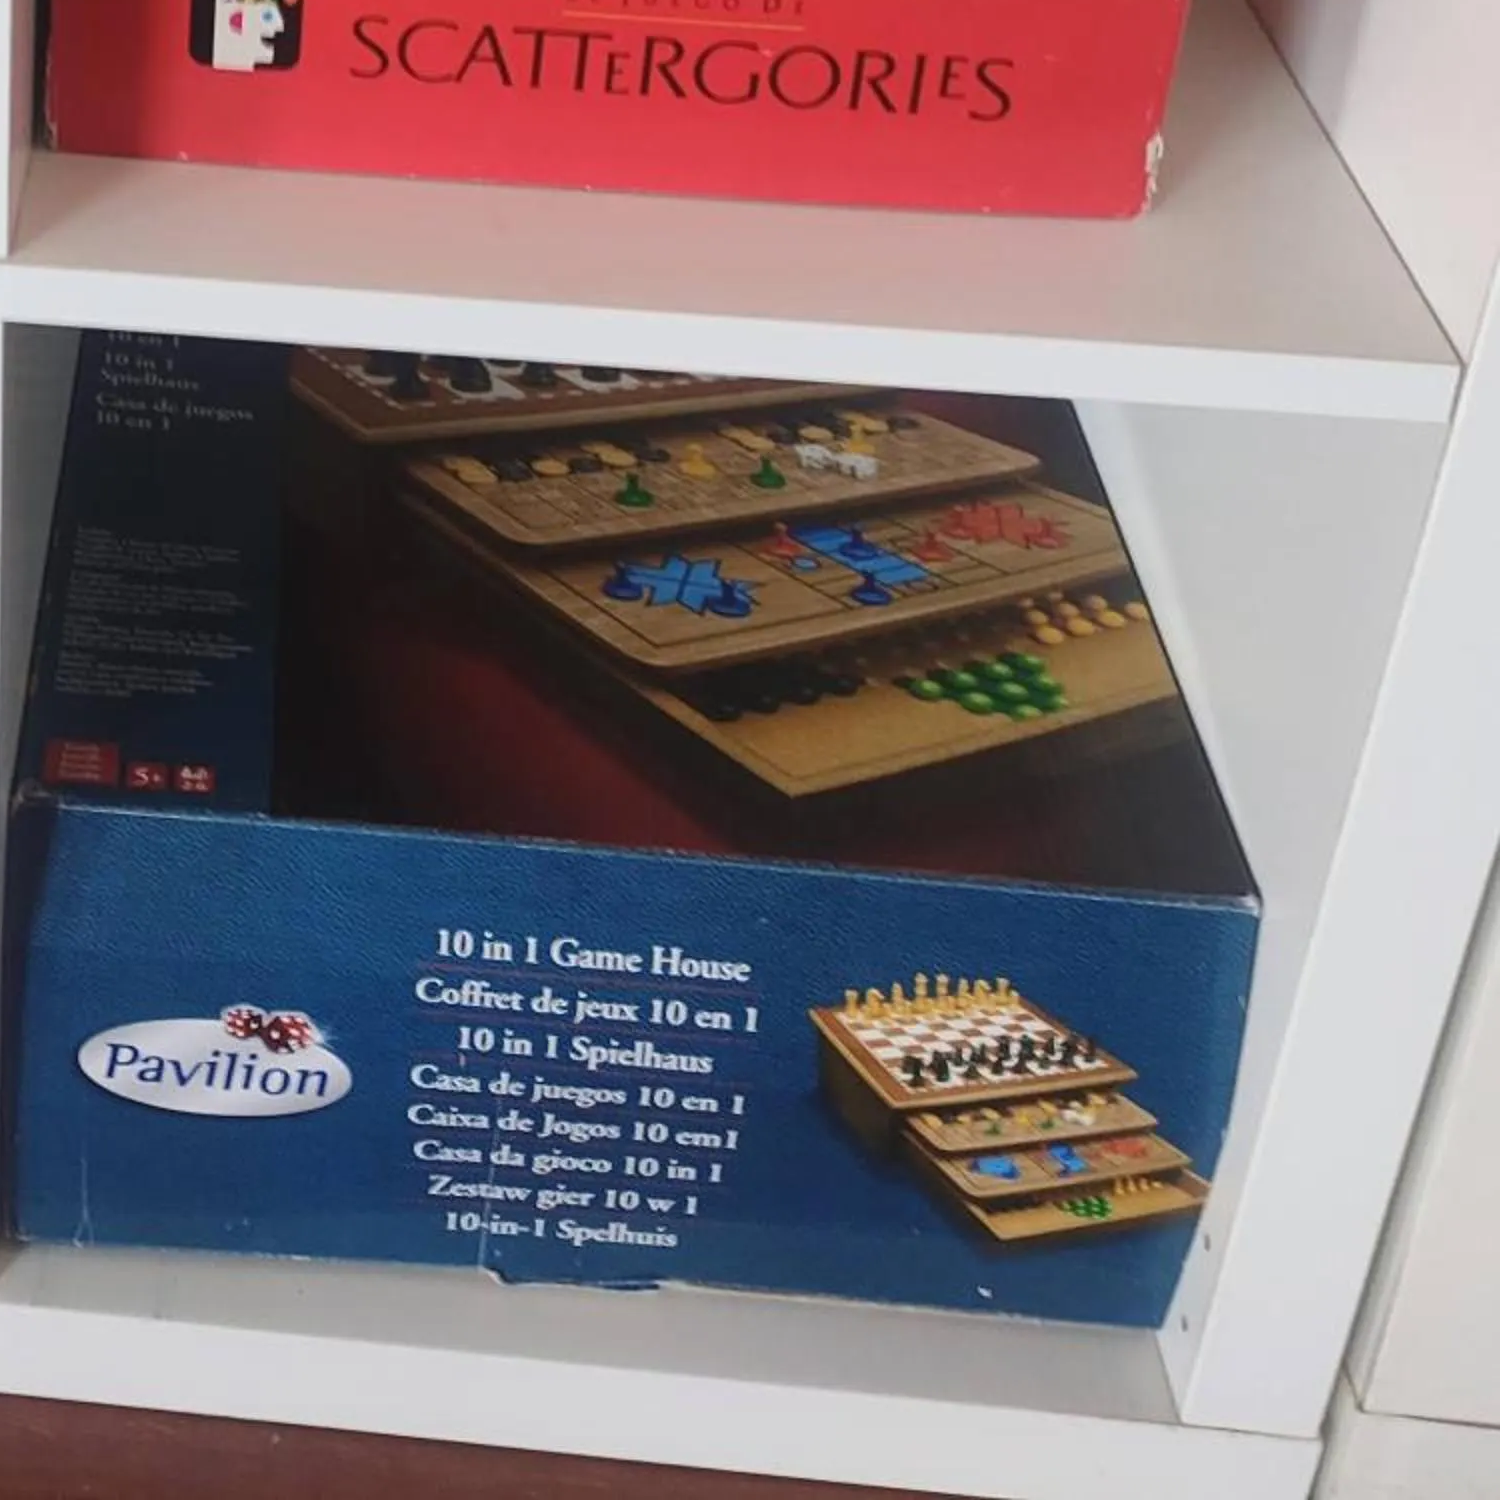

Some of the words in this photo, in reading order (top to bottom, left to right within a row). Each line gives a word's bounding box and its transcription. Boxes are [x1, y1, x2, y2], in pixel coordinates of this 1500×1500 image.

[349, 14, 1015, 122] SCATTERGORIES
[436, 929, 474, 959] 10
[482, 931, 513, 962] in
[525, 936, 538, 965] 1
[551, 937, 643, 974] Game
[651, 945, 752, 982] House
[415, 977, 524, 1011] Coffret
[531, 987, 569, 1015] de
[573, 991, 640, 1024] jeux
[650, 1000, 687, 1026] 10
[694, 1008, 732, 1031] en
[745, 1007, 758, 1033] 1
[106, 1043, 329, 1097] Pavilion
[458, 1026, 495, 1052] 10
[502, 1029, 533, 1057] in
[546, 1035, 559, 1059] 1
[569, 1035, 714, 1074] Spielhaus
[410, 1064, 482, 1094] Casa
[488, 1072, 526, 1096] de
[531, 1077, 627, 1108] juegos
[638, 1087, 675, 1108] 10
[682, 1092, 720, 1113] en
[731, 1095, 745, 1115] 1
[407, 1104, 490, 1130] Caixa
[497, 1110, 535, 1133] de
[537, 1113, 622, 1143] Jogos
[632, 1122, 669, 1144] 10
[413, 1139, 483, 1164] Casa
[490, 1144, 526, 1168] da
[531, 1150, 613, 1176] gioco
[623, 1156, 660, 1178] 10
[667, 1159, 698, 1182] in
[708, 1163, 723, 1183] 1
[427, 1174, 533, 1201] Zestaw
[535, 1184, 597, 1211] gier
[603, 1189, 641, 1210] 10
[646, 1197, 677, 1214] w
[684, 1196, 699, 1216] 1
[446, 1211, 546, 1238] 10-in-1
[555, 1218, 679, 1249] Spelhuis
